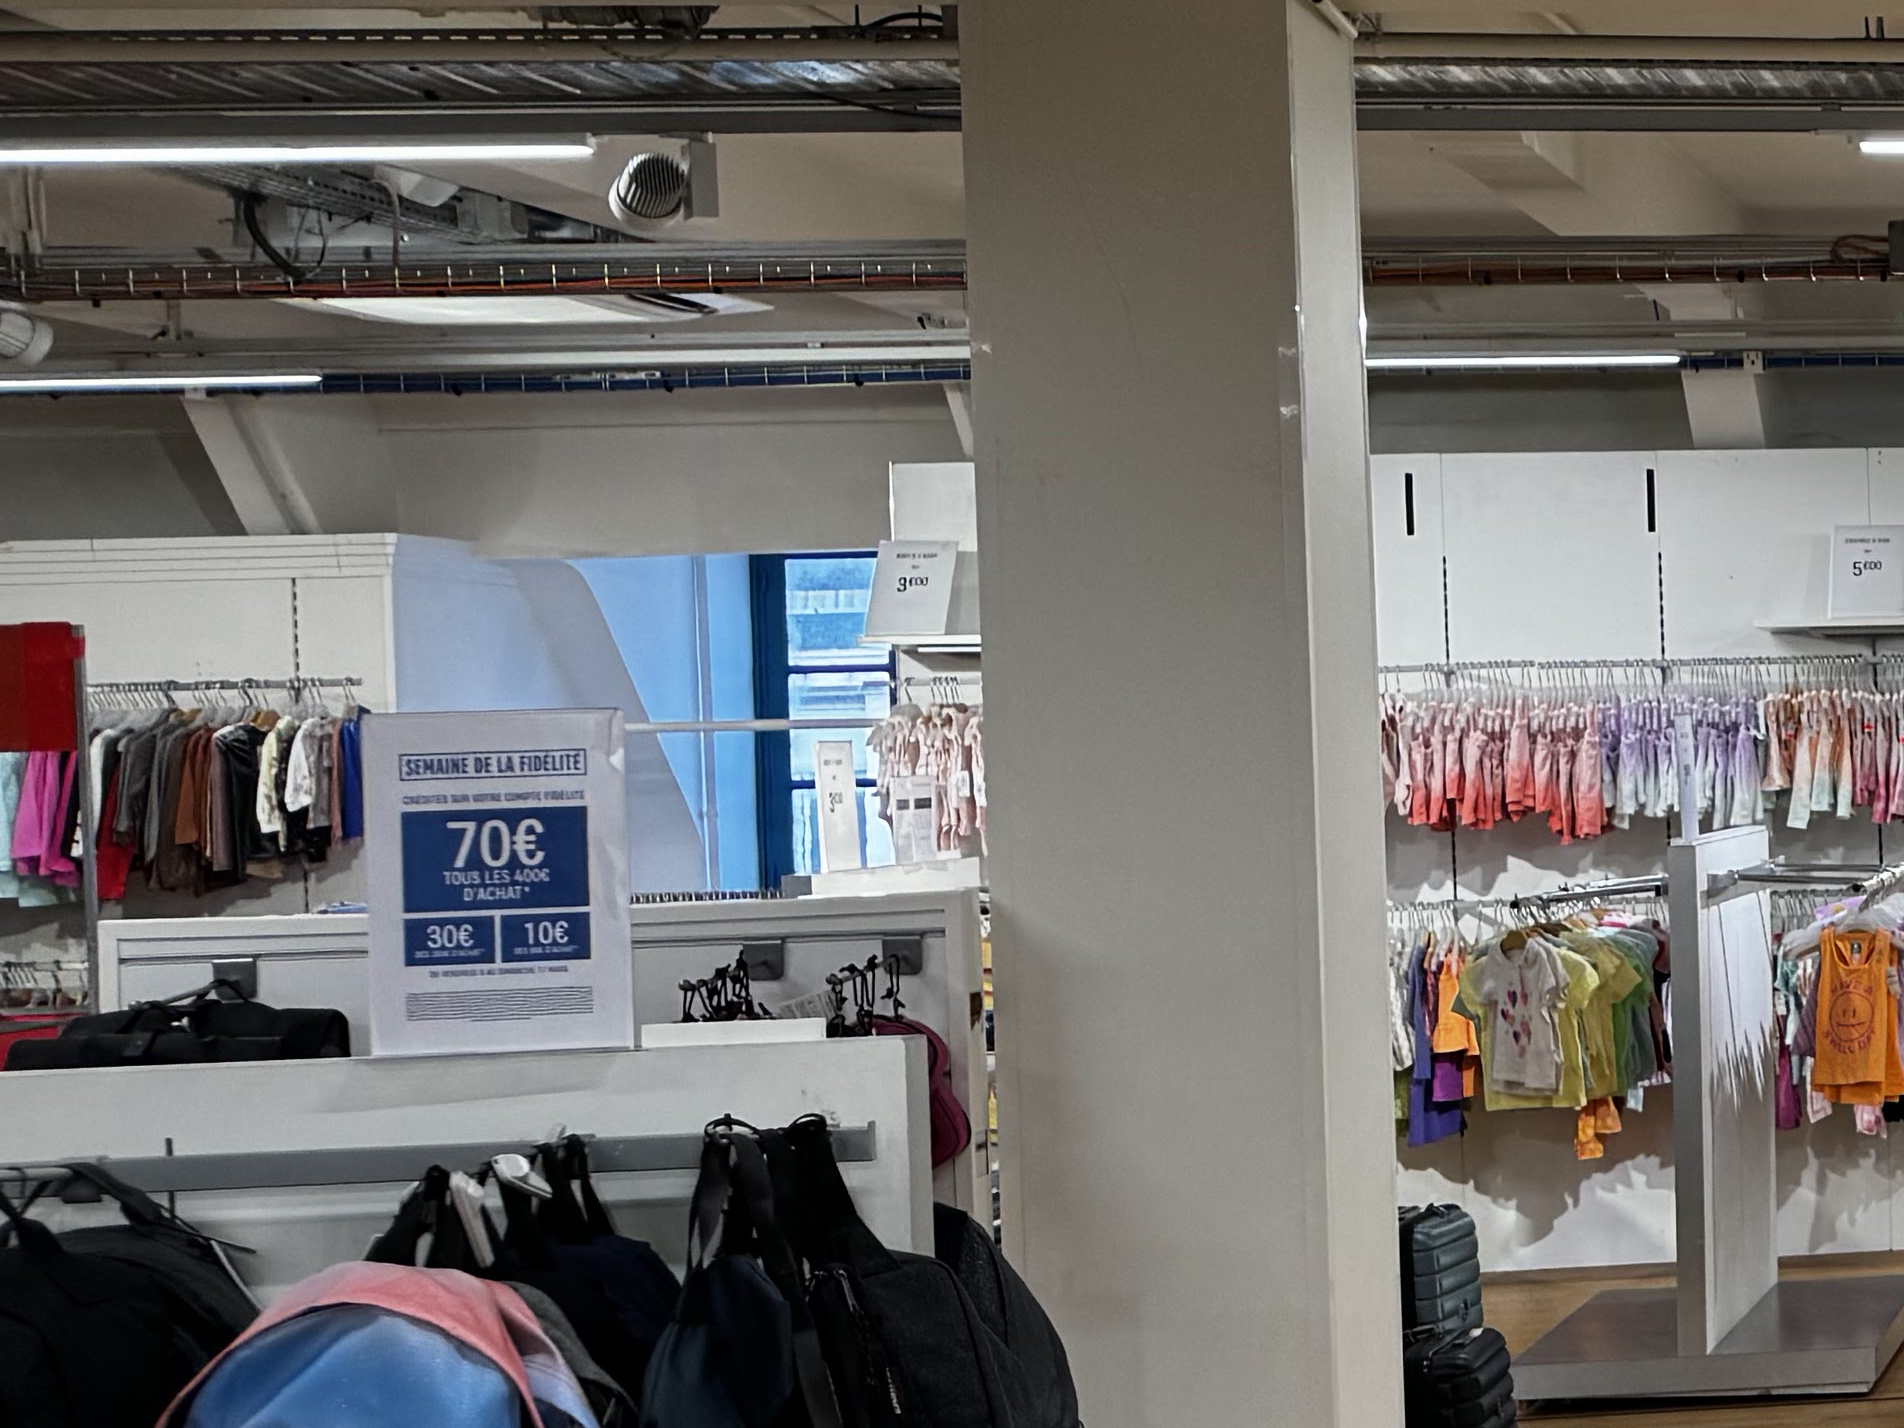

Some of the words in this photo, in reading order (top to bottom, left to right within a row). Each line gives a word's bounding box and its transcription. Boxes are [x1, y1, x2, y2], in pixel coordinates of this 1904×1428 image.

[405, 757, 469, 776] SEMAINE
[474, 756, 491, 774] DE
[497, 755, 515, 773] LA
[446, 818, 545, 868] 70€
[443, 871, 480, 885] TOUS
[485, 870, 511, 884] LES
[426, 924, 475, 948] 30€
[524, 921, 569, 945] 10€
